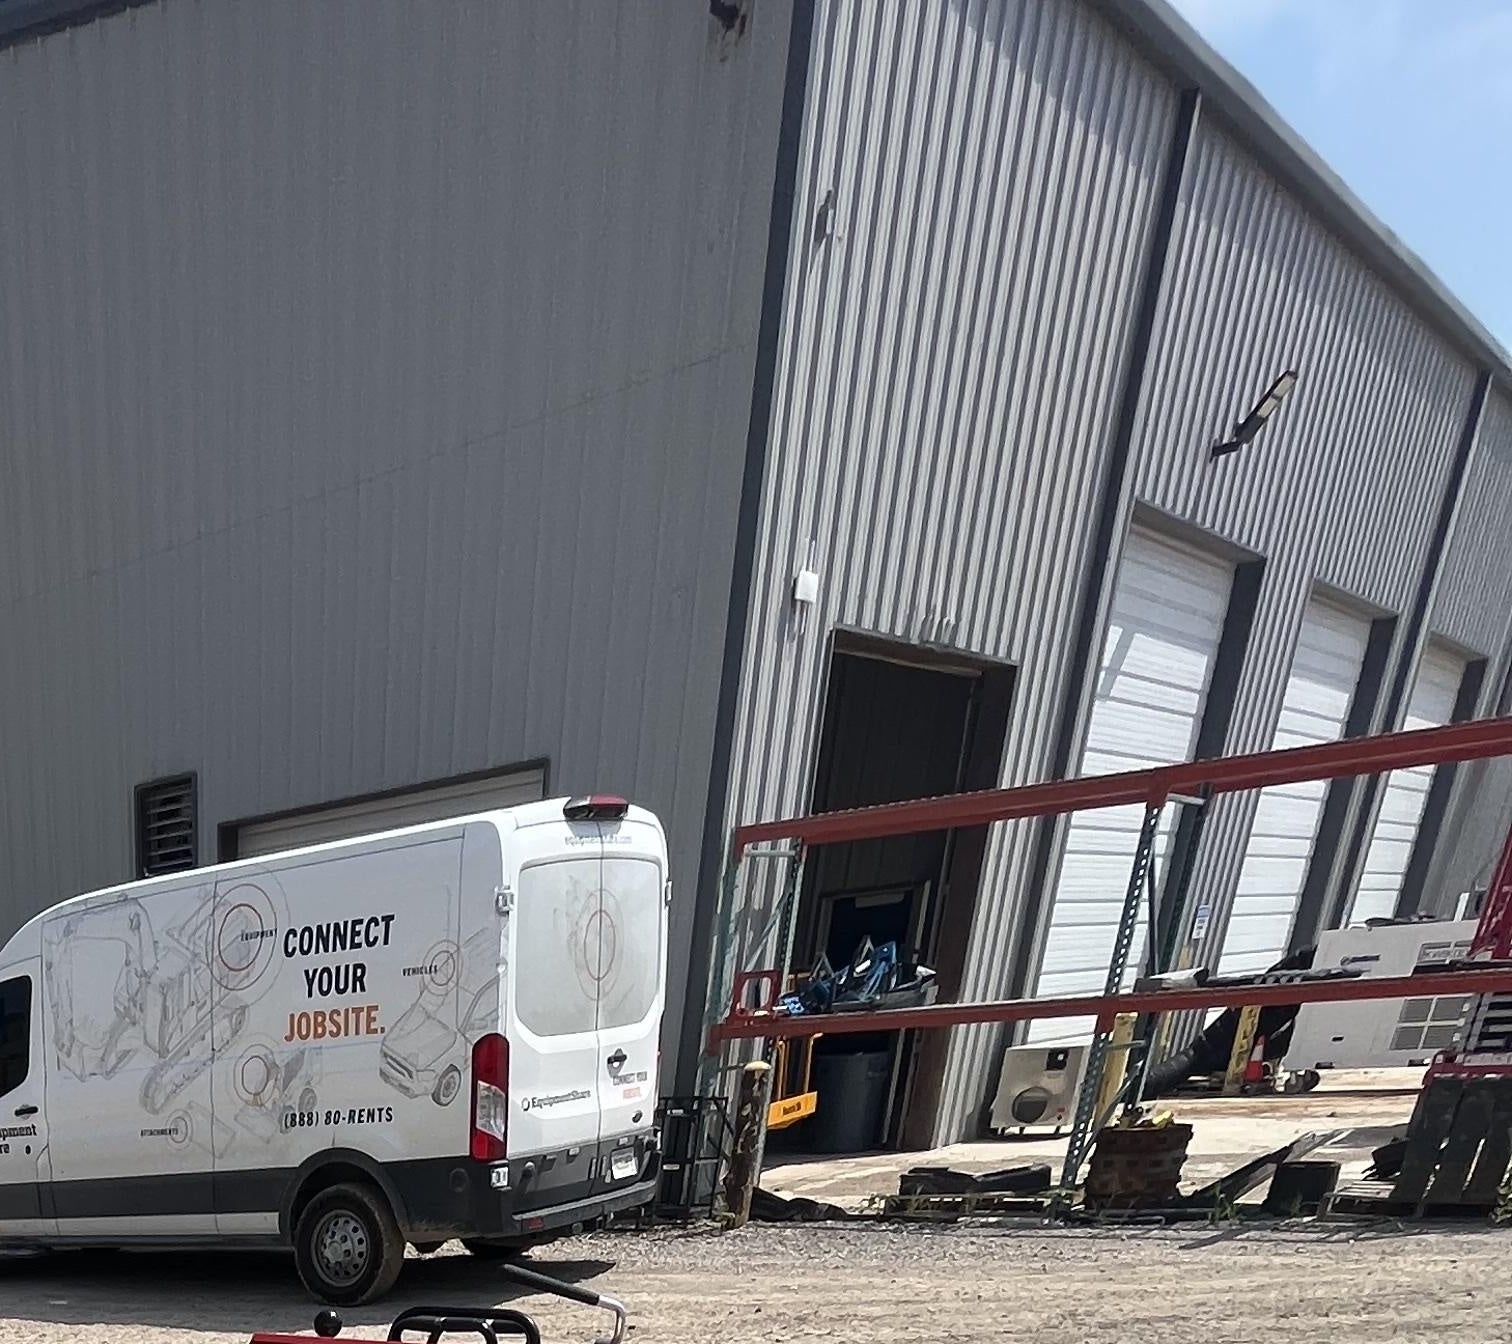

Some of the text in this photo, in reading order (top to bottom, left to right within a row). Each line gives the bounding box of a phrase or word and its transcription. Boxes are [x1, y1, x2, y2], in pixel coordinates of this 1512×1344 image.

[283, 914, 396, 958] CONNECT
[304, 963, 367, 999] YOUR
[284, 1005, 386, 1042] JOBSITE.
[284, 1107, 393, 1129] (888) 80-RENTS
